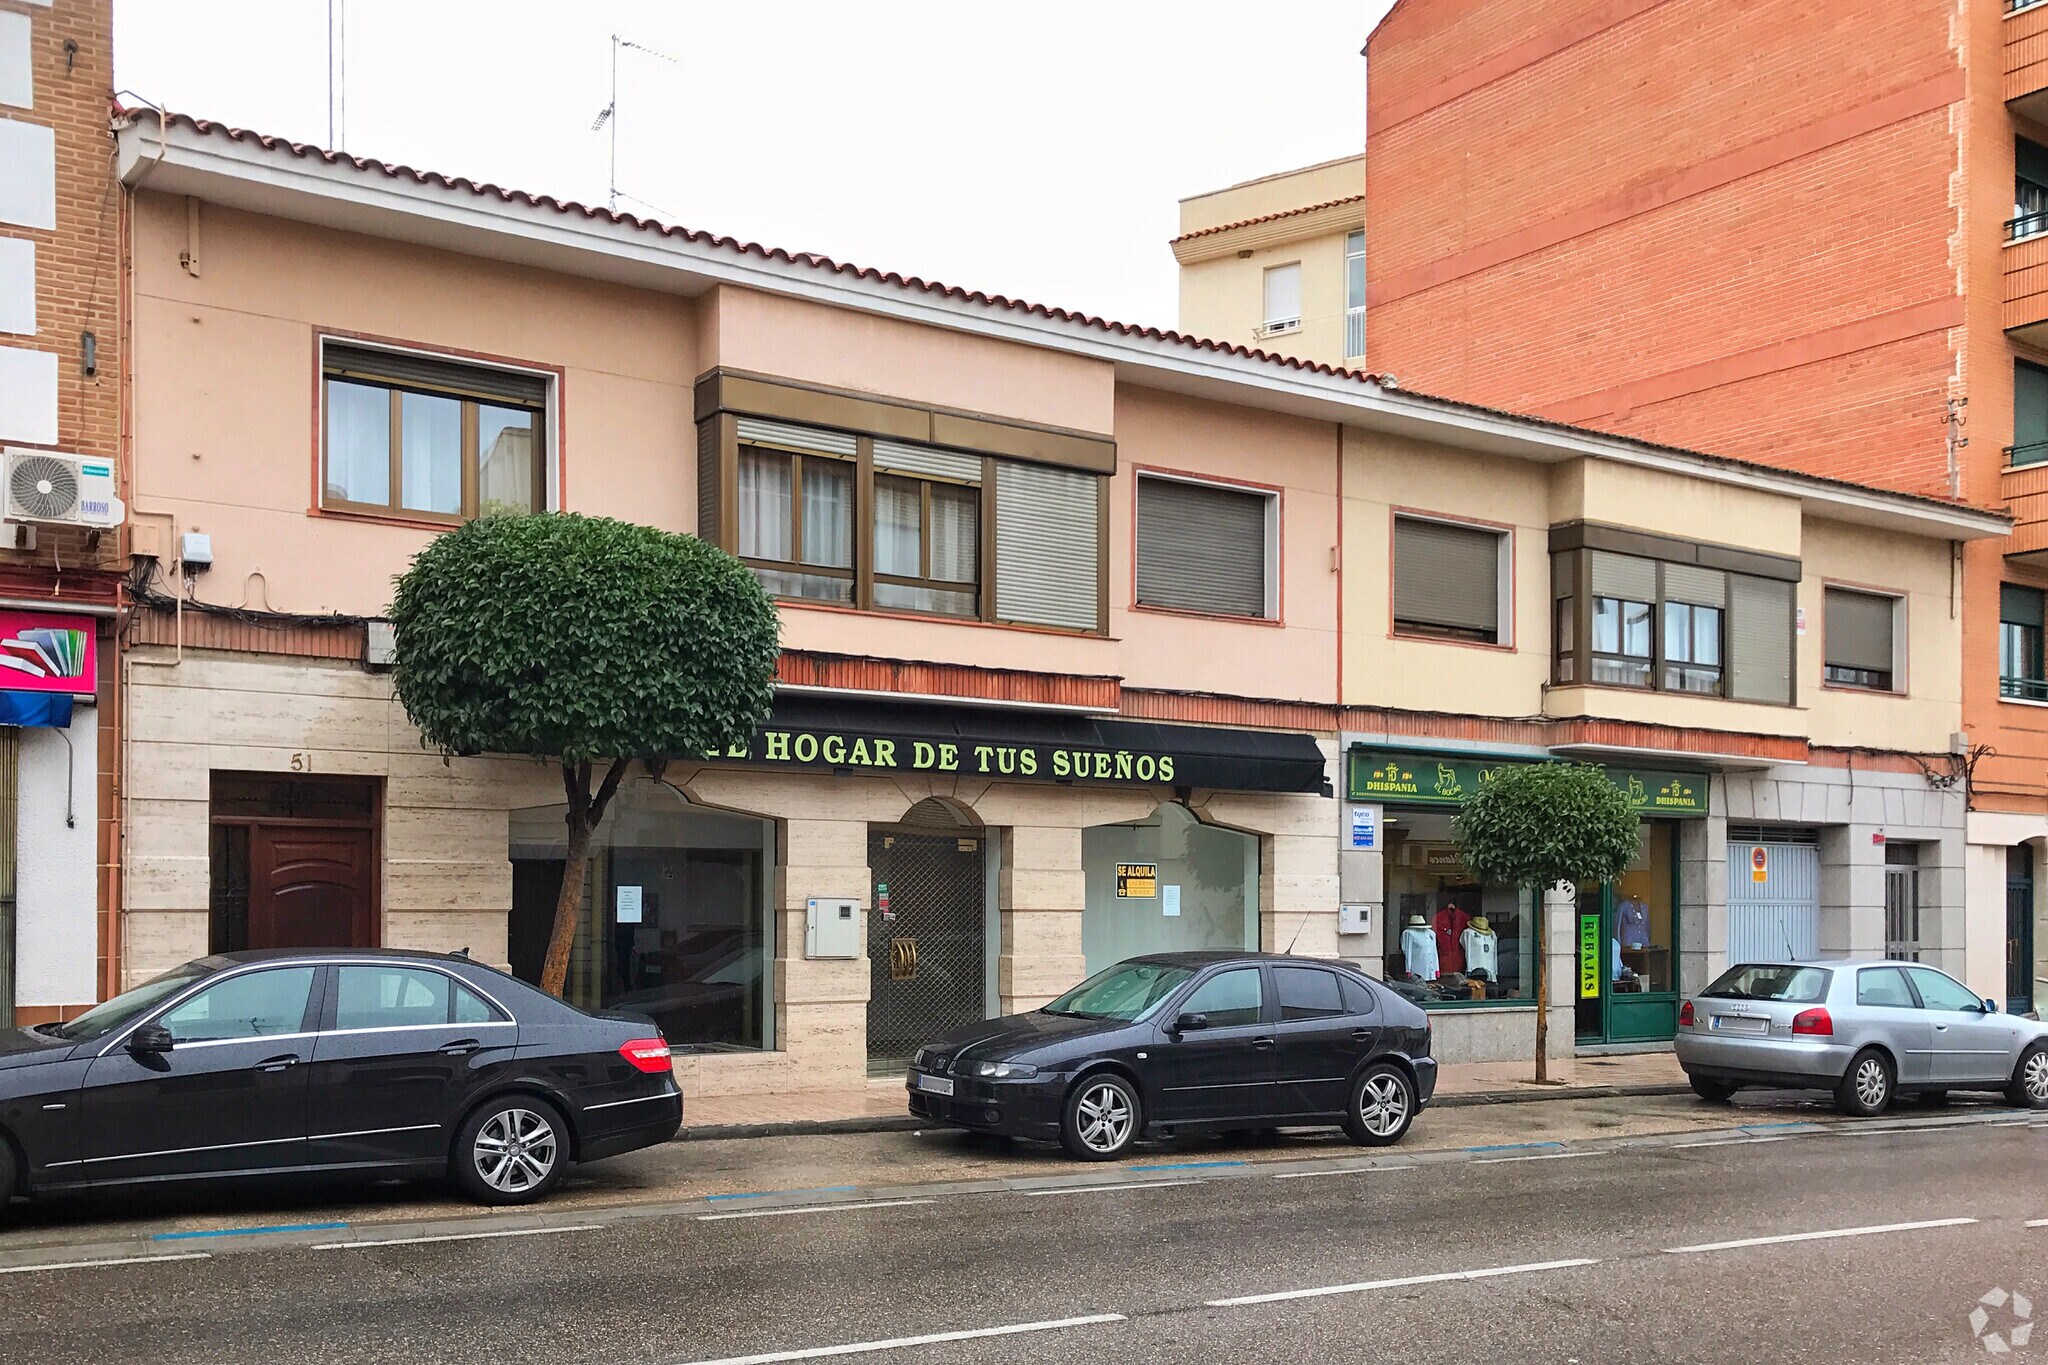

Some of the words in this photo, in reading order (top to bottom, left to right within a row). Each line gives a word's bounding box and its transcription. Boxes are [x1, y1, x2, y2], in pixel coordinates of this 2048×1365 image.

[81, 501, 109, 513] BARROSO
[290, 753, 312, 772] 51
[764, 731, 898, 767] HOGAR
[912, 741, 960, 771] DE
[974, 746, 1038, 775] TUS
[1052, 749, 1175, 782] SUEÑOS
[1366, 781, 1418, 793] DHISPANIA
[1656, 796, 1696, 806] DHISPANIA
[1117, 865, 1127, 877] SE
[1127, 865, 1156, 877] ALQUILA
[1585, 921, 1595, 991] REBAJAS
